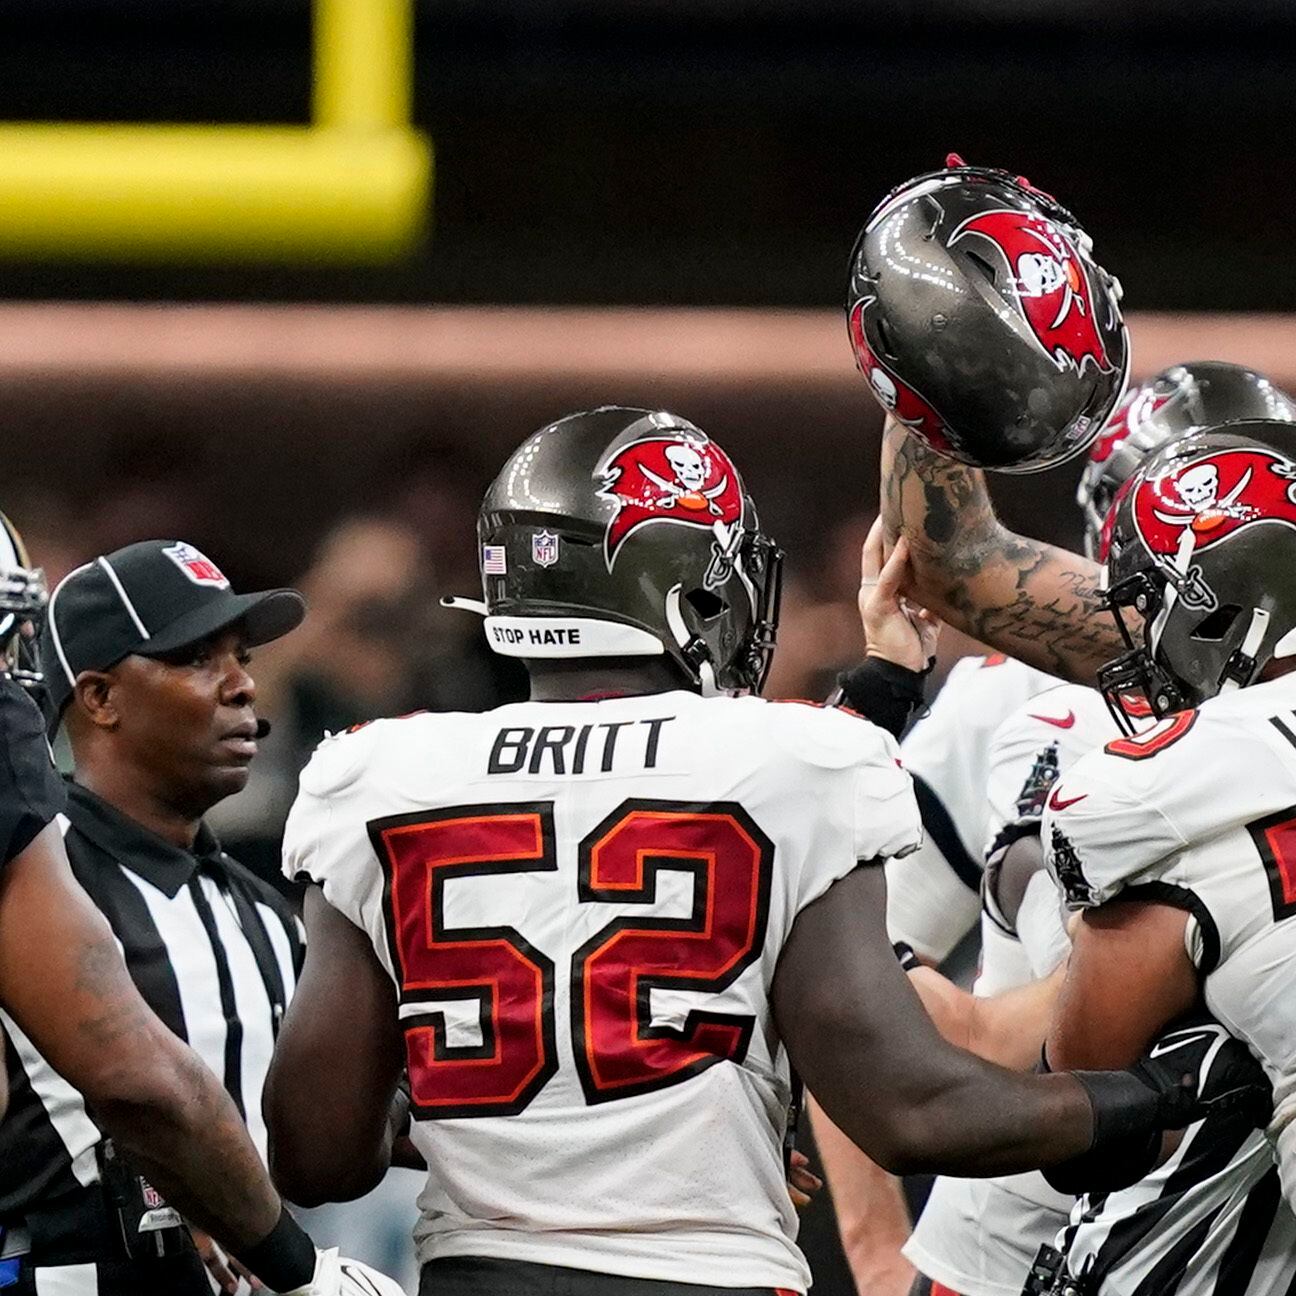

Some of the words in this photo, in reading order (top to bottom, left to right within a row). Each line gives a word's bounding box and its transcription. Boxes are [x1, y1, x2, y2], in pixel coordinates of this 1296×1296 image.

[536, 547, 553, 560] NFL
[493, 627, 524, 644] STOP
[529, 629, 580, 644] HATE
[487, 715, 676, 776] BRITT
[366, 797, 776, 1121] 52
